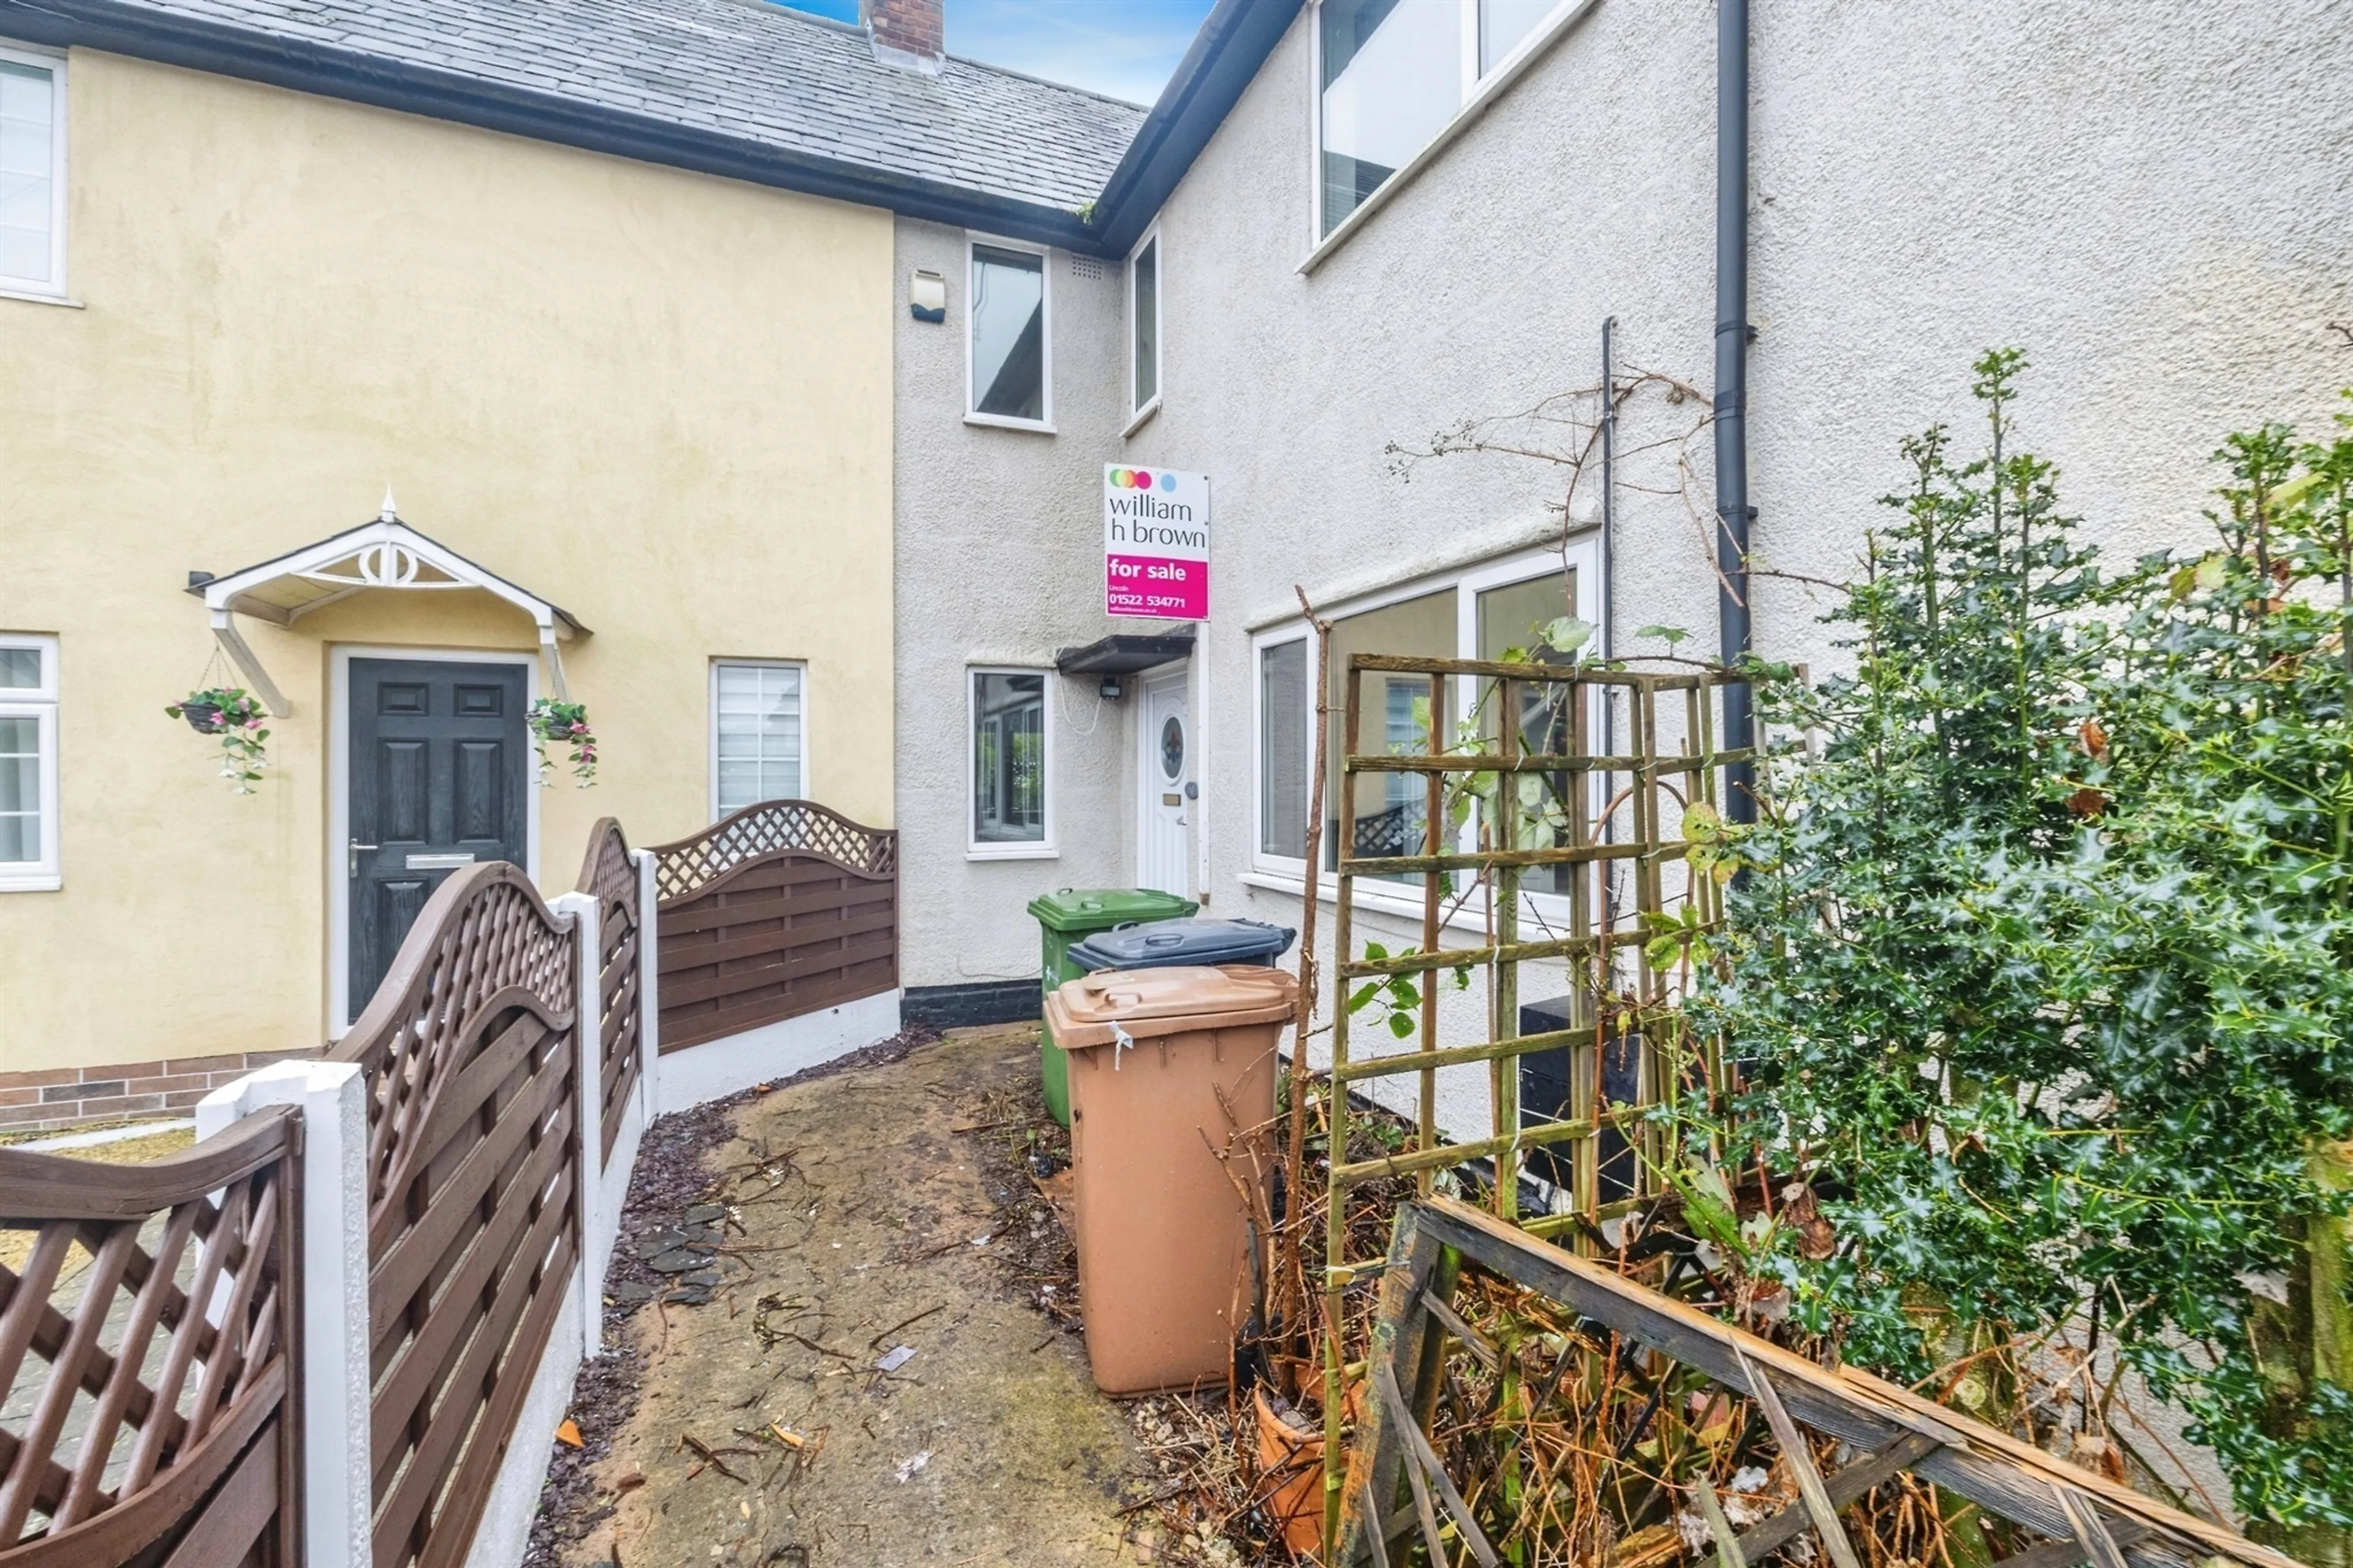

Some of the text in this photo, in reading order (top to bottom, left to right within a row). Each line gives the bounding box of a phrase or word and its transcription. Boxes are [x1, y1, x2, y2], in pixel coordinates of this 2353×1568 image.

[1110, 494, 1191, 521] william
[1112, 518, 1205, 548] h brown
[1110, 559, 1186, 581] for sale
[1109, 594, 1186, 608] 01522 534771
